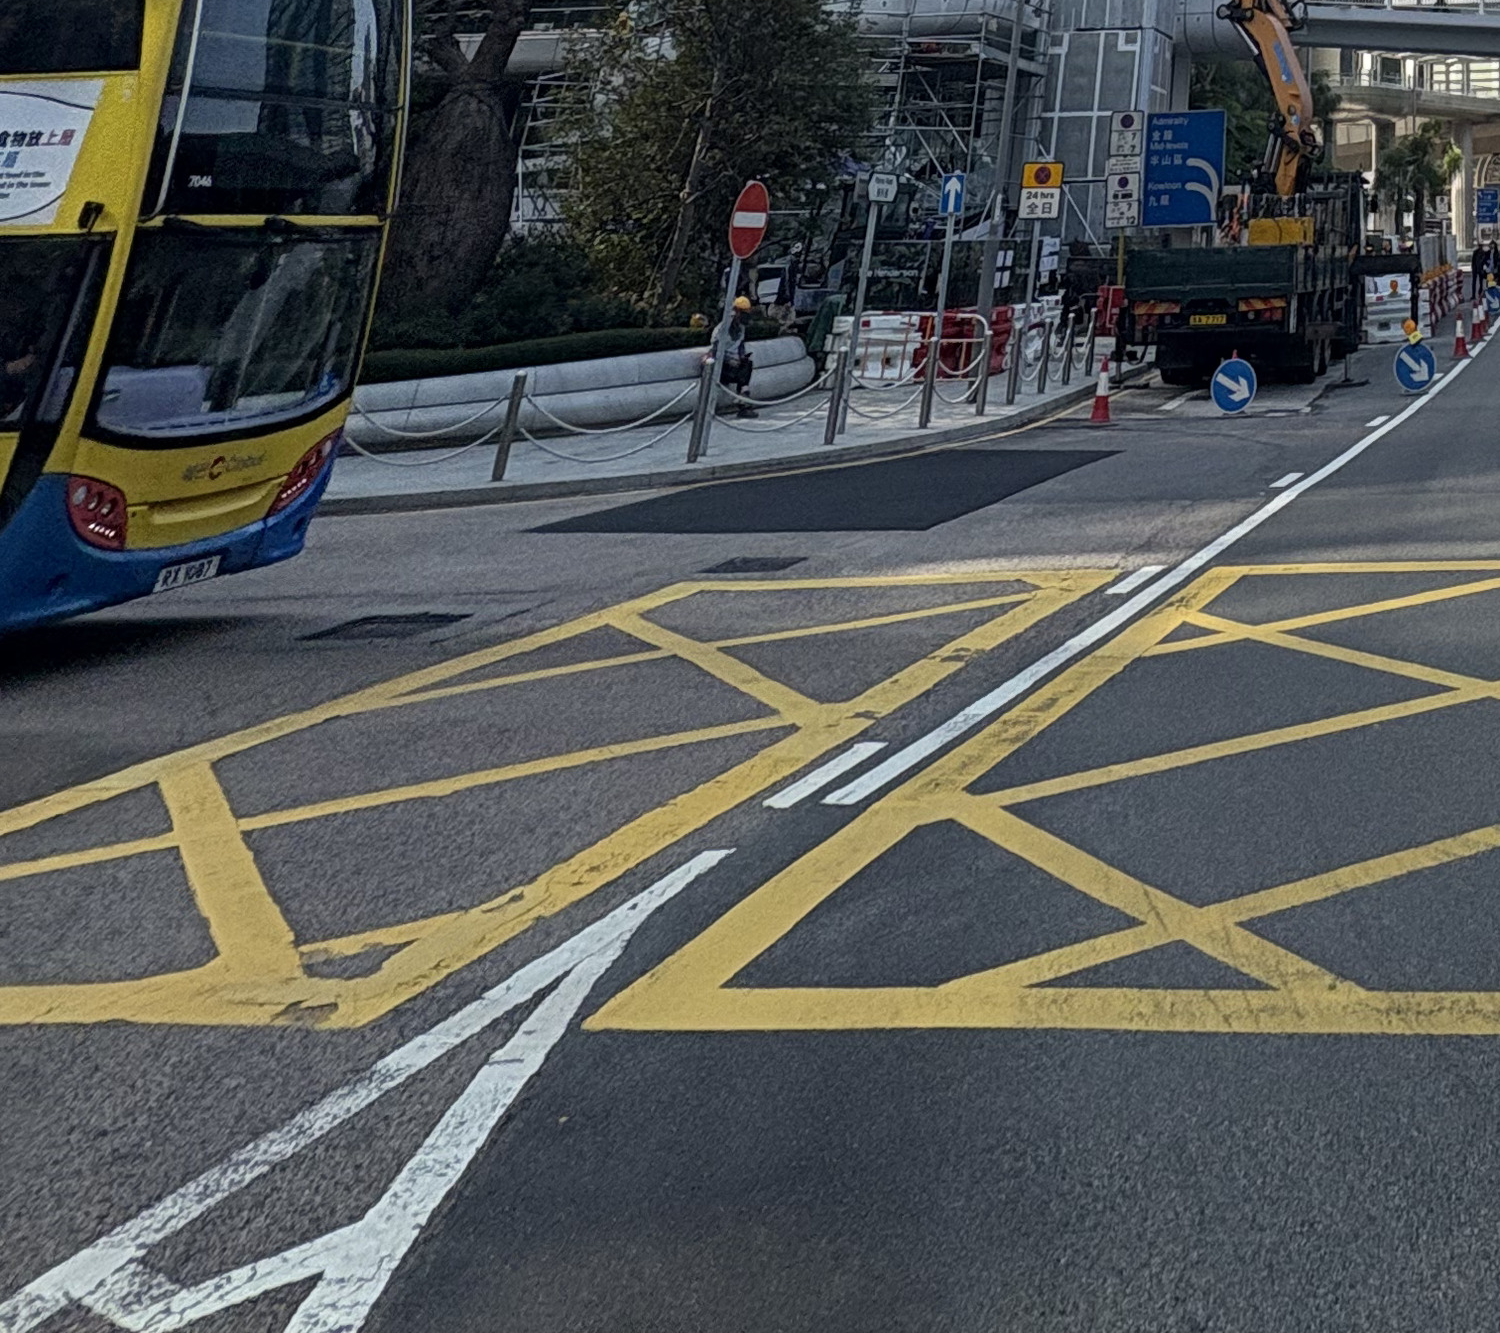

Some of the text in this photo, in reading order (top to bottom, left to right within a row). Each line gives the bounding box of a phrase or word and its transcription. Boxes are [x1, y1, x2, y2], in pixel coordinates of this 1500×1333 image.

[1026, 191, 1055, 200] 24 hrs
[1026, 202, 1052, 215] 全日
